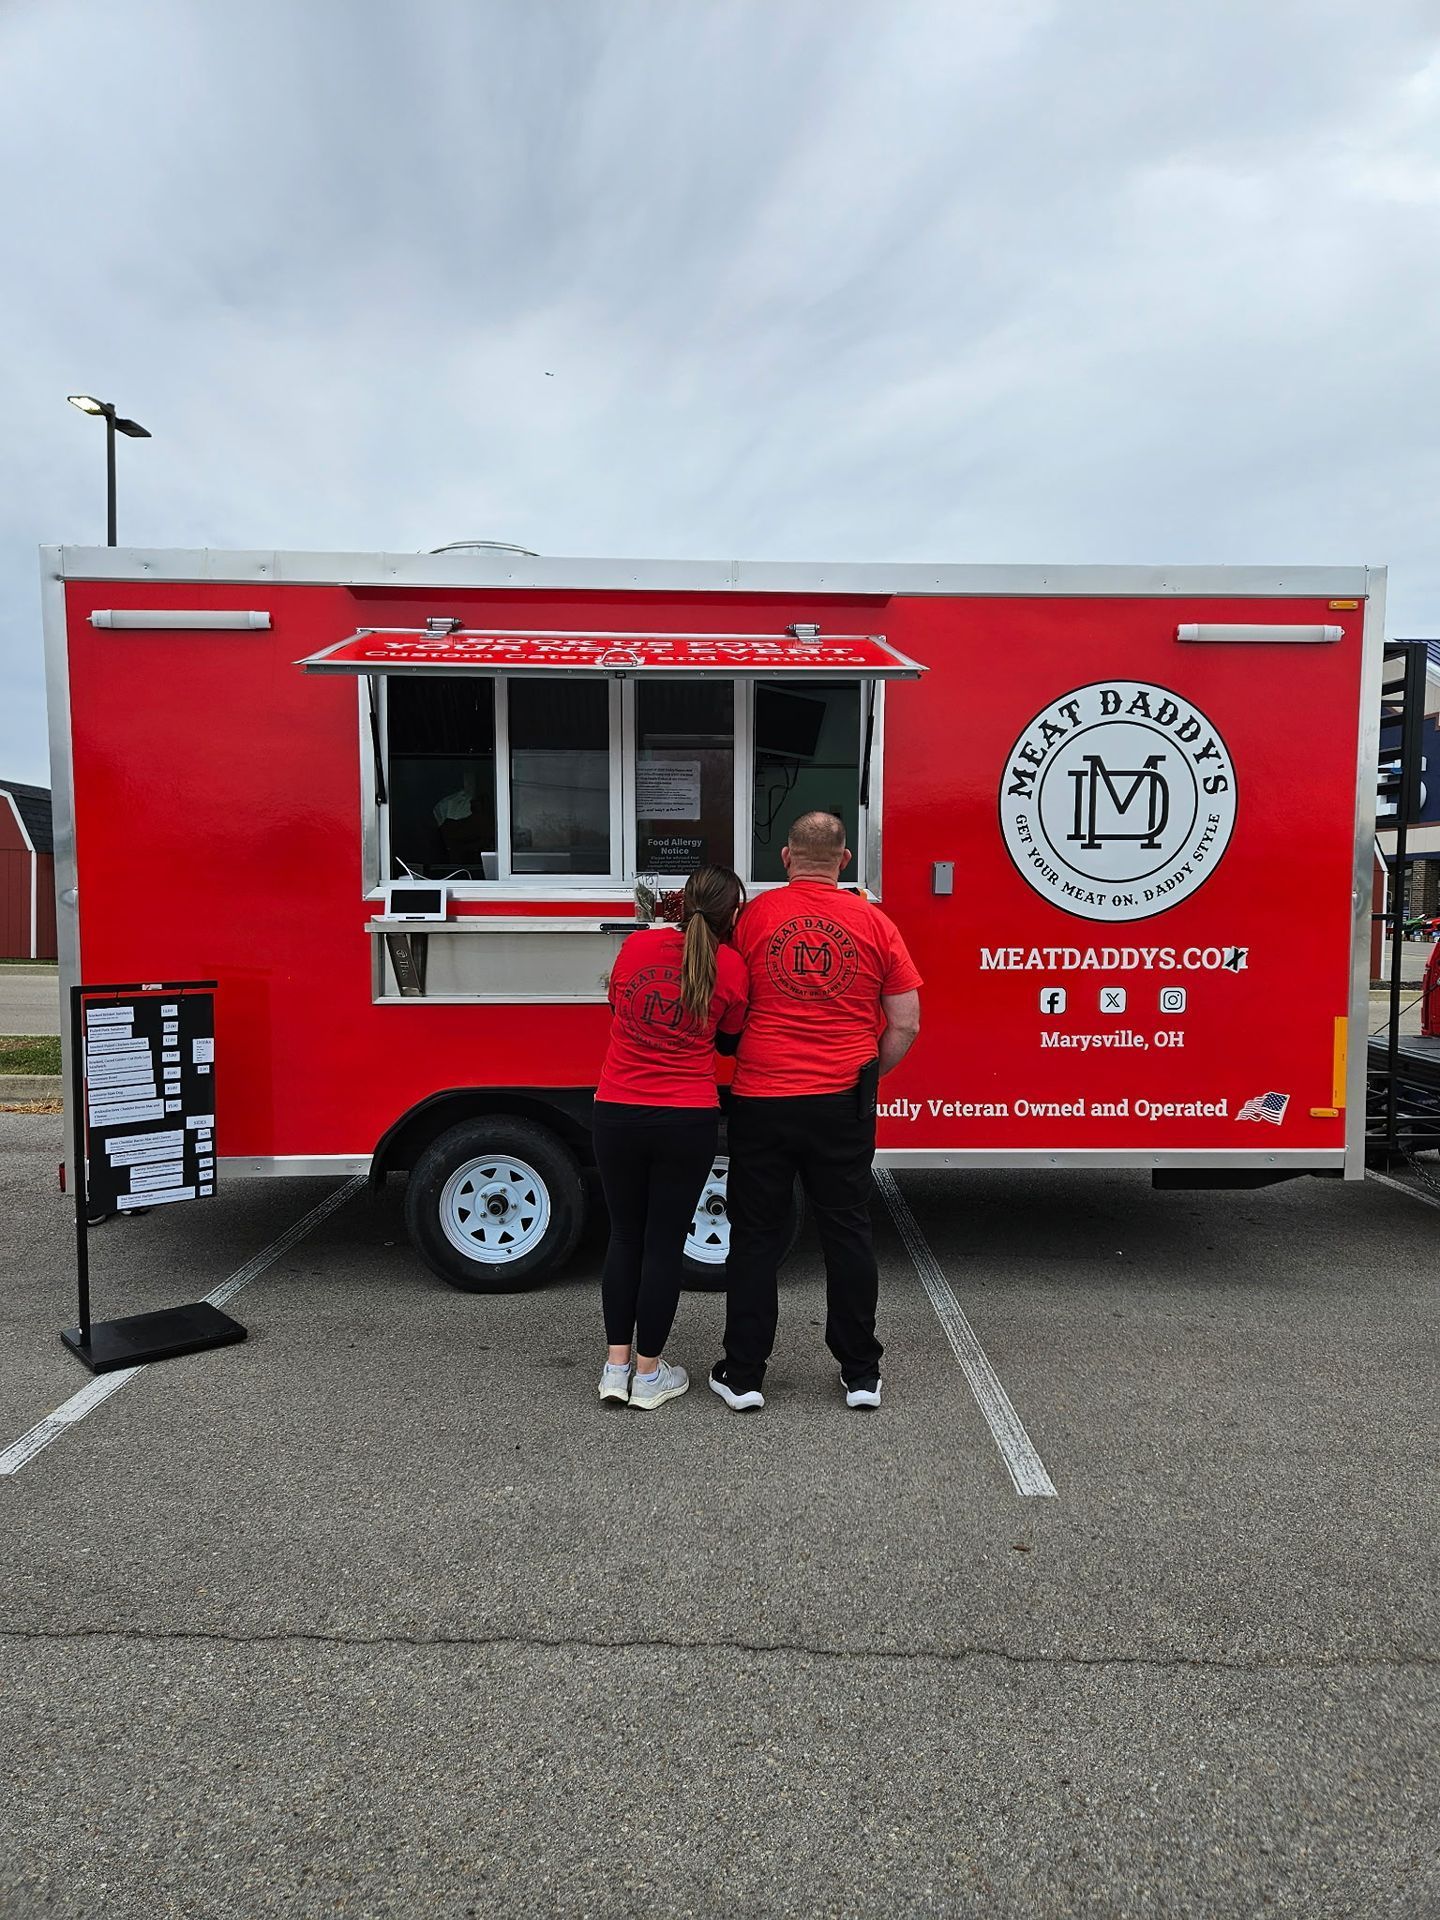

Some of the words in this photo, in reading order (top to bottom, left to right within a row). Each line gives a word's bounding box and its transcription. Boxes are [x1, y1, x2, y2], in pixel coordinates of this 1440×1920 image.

[384, 642, 521, 651] YOUR
[536, 645, 674, 654] NEXT
[462, 637, 597, 646] BOOK
[365, 651, 493, 659] Custom
[1008, 699, 1083, 800] MEAT
[1099, 689, 1229, 795] DADDY'S
[660, 847, 690, 855] Notice
[671, 838, 702, 848] Allergy
[1015, 813, 1033, 844] GET
[1027, 846, 1060, 886] YOUR
[1061, 881, 1107, 906] MEAT
[1143, 863, 1194, 902] DADDY
[1192, 812, 1221, 862] STYLE
[770, 920, 799, 957] MEAT
[804, 918, 856, 959] DADDY'S
[624, 969, 657, 1000] MEAT
[1040, 1030, 1149, 1052] Marysville,
[1153, 1031, 1185, 1048] OH
[876, 1098, 922, 1121] udly
[927, 1099, 1009, 1117] Veteran
[1013, 1098, 1086, 1117] Owned
[1090, 1098, 1130, 1117] and
[1134, 1098, 1228, 1121] Operated
